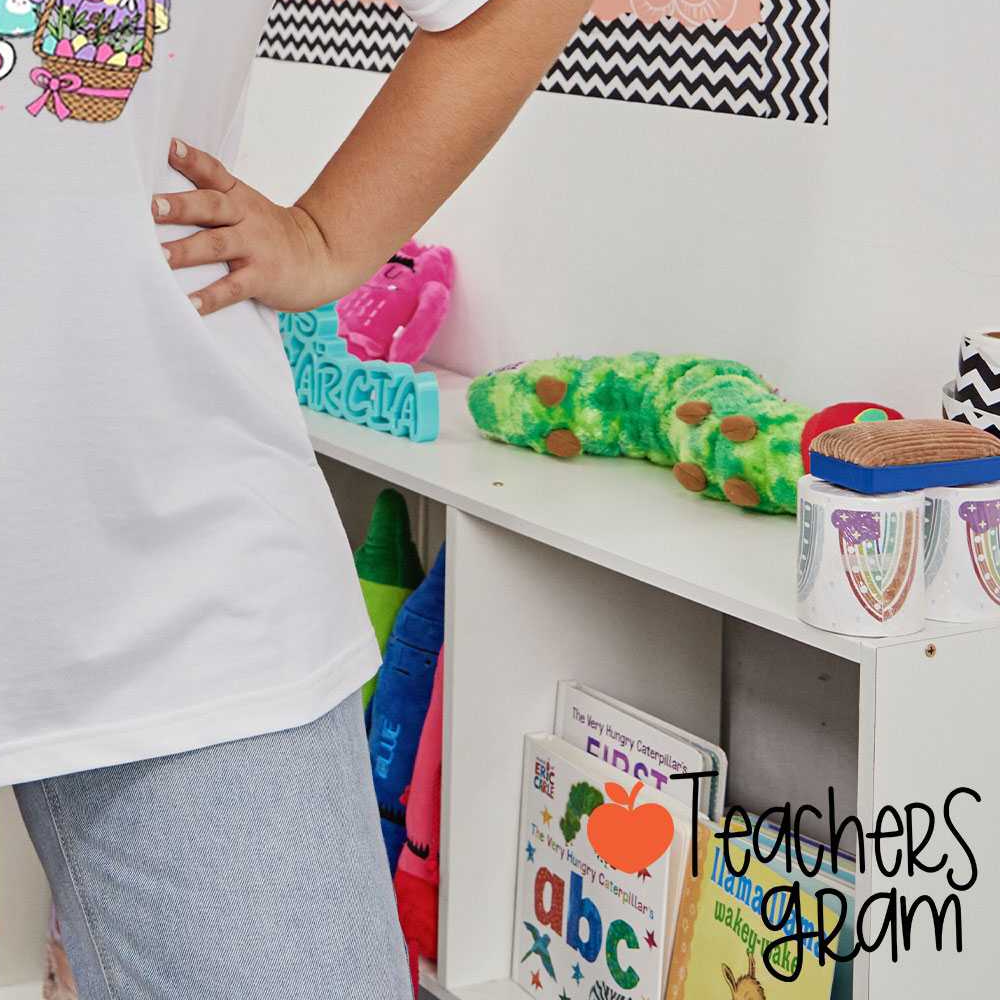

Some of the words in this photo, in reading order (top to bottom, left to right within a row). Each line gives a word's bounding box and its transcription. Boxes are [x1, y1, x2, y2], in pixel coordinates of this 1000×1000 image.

[374, 717, 402, 780] BLUE
[571, 705, 586, 724] The
[587, 713, 604, 736] Very
[606, 724, 636, 752] Hungry
[636, 739, 689, 774] Caterpillar's
[533, 775, 556, 800] CARLE
[535, 761, 556, 786] ERIC
[530, 822, 545, 842] The
[547, 834, 566, 860] Very
[566, 848, 597, 884] Hungry
[598, 872, 655, 921] Caterpillar's
[534, 866, 641, 991] abc
